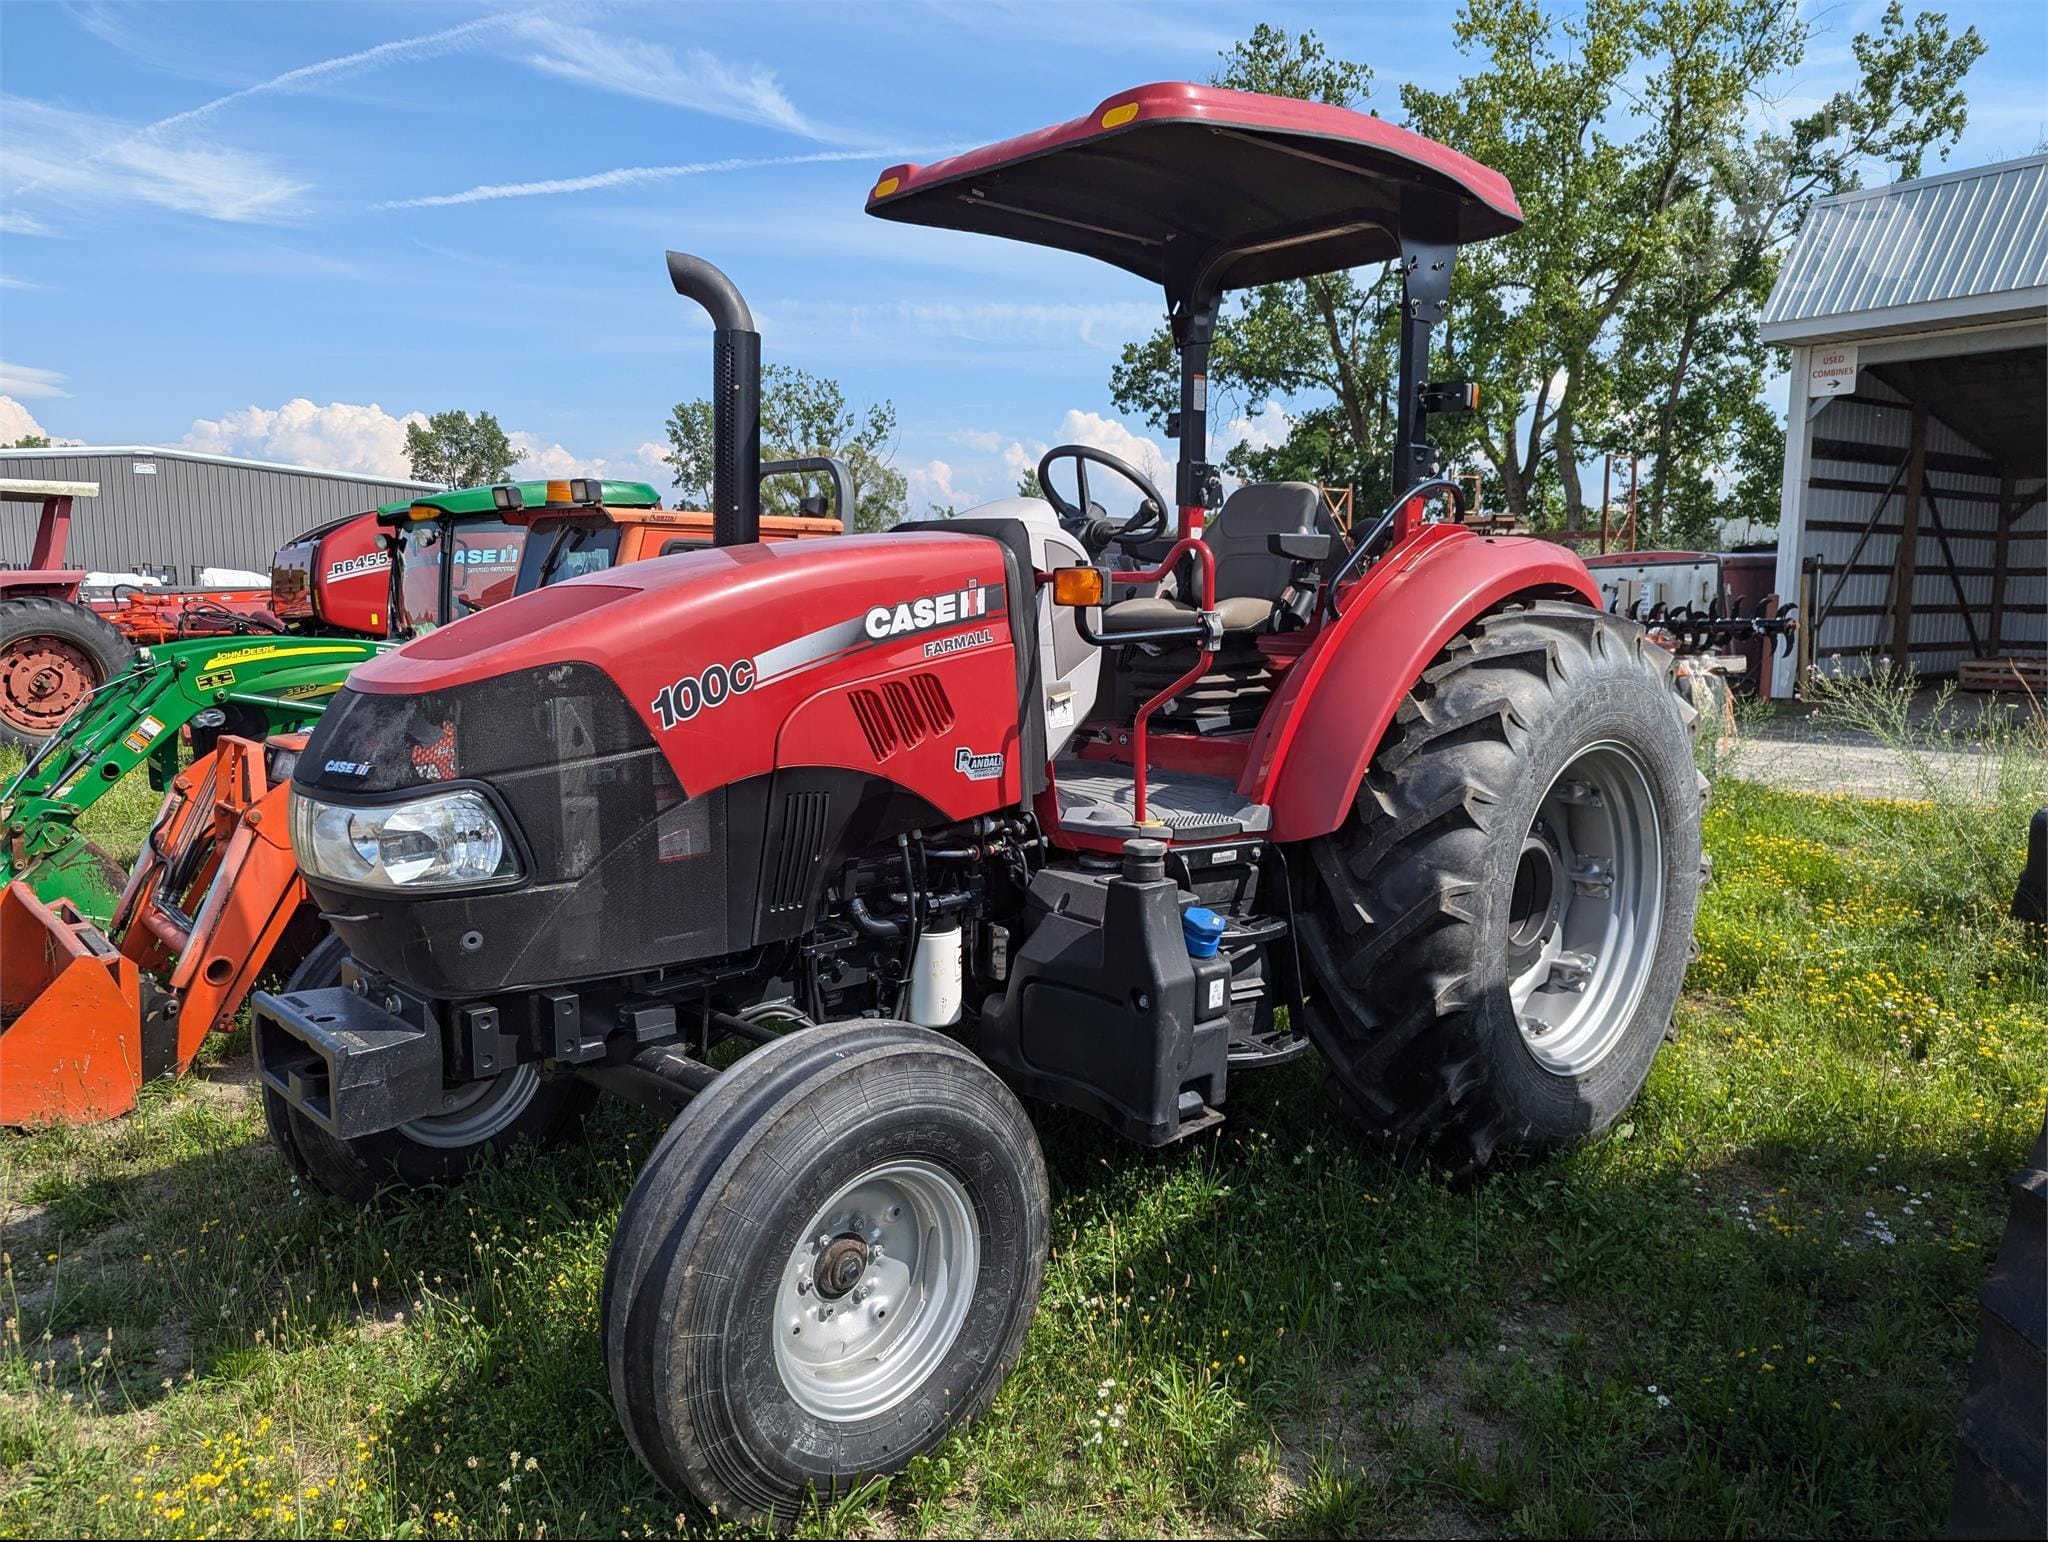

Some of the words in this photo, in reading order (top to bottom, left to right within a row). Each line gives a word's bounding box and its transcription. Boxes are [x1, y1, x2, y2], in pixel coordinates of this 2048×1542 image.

[1823, 355, 1845, 365] USED
[1812, 367, 1854, 378] COMBINES
[333, 552, 388, 574] RB455
[865, 593, 956, 639] CASE
[924, 629, 994, 658] FARMALL
[214, 651, 241, 661] JOHN
[242, 645, 276, 656] DEERE
[286, 683, 316, 697] 3320
[651, 659, 755, 730] 100C
[325, 760, 355, 773] CASE
[956, 749, 1003, 770] RANDALL
